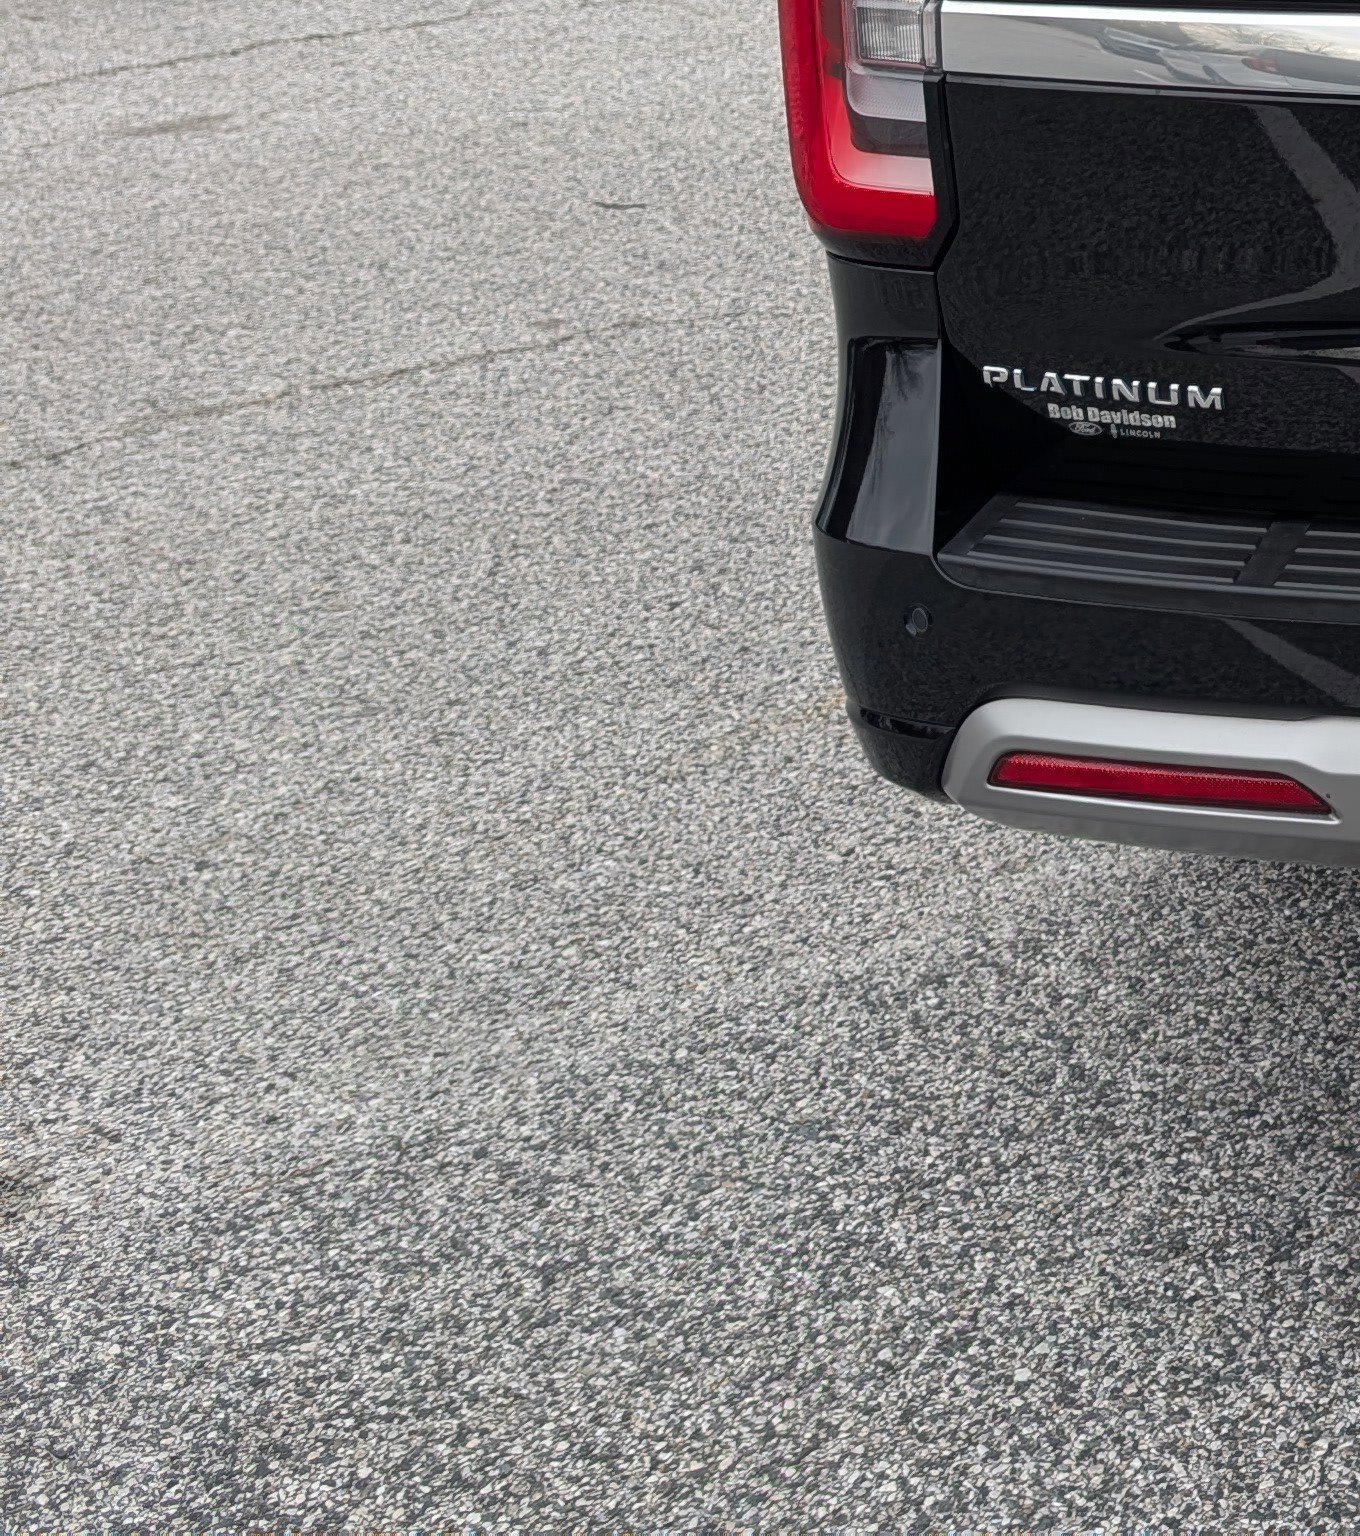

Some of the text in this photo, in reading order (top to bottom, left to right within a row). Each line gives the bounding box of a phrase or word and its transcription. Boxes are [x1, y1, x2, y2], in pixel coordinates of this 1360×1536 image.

[982, 365, 1226, 410] PLATINUM
[1047, 402, 1177, 429] Bob Davidson
[1119, 428, 1161, 439] LINCOLN
